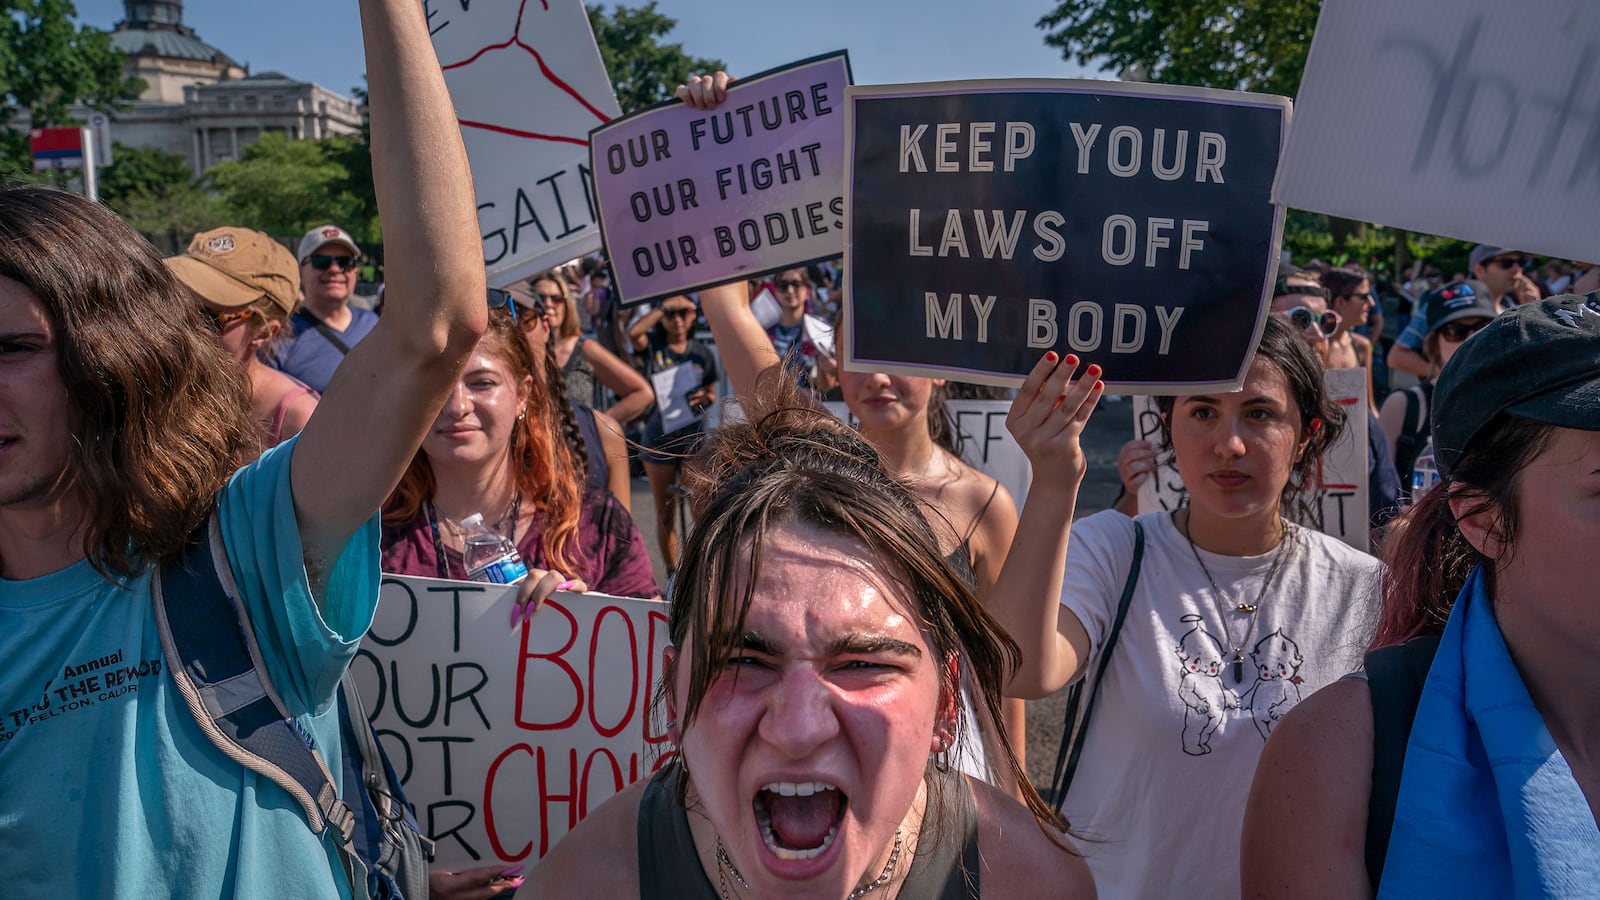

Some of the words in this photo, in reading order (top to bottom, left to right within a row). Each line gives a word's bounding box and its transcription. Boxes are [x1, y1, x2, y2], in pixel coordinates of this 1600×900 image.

[608, 129, 672, 175] OUR
[690, 82, 833, 151] FUTURE
[899, 122, 1036, 173] KEEP
[1069, 122, 1227, 184] YOUR
[630, 178, 700, 223] OUR
[716, 142, 822, 200] FIGHT
[632, 235, 701, 278] OUR
[714, 196, 843, 258] BODIES
[909, 208, 1066, 262] LAWS
[1102, 214, 1209, 270] OFF
[925, 291, 998, 343] MY
[1027, 298, 1185, 355] BODY
[367, 578, 486, 652] OT
[54, 676, 101, 702] THE
[63, 648, 123, 681] Annual
[349, 648, 491, 729] OUR
